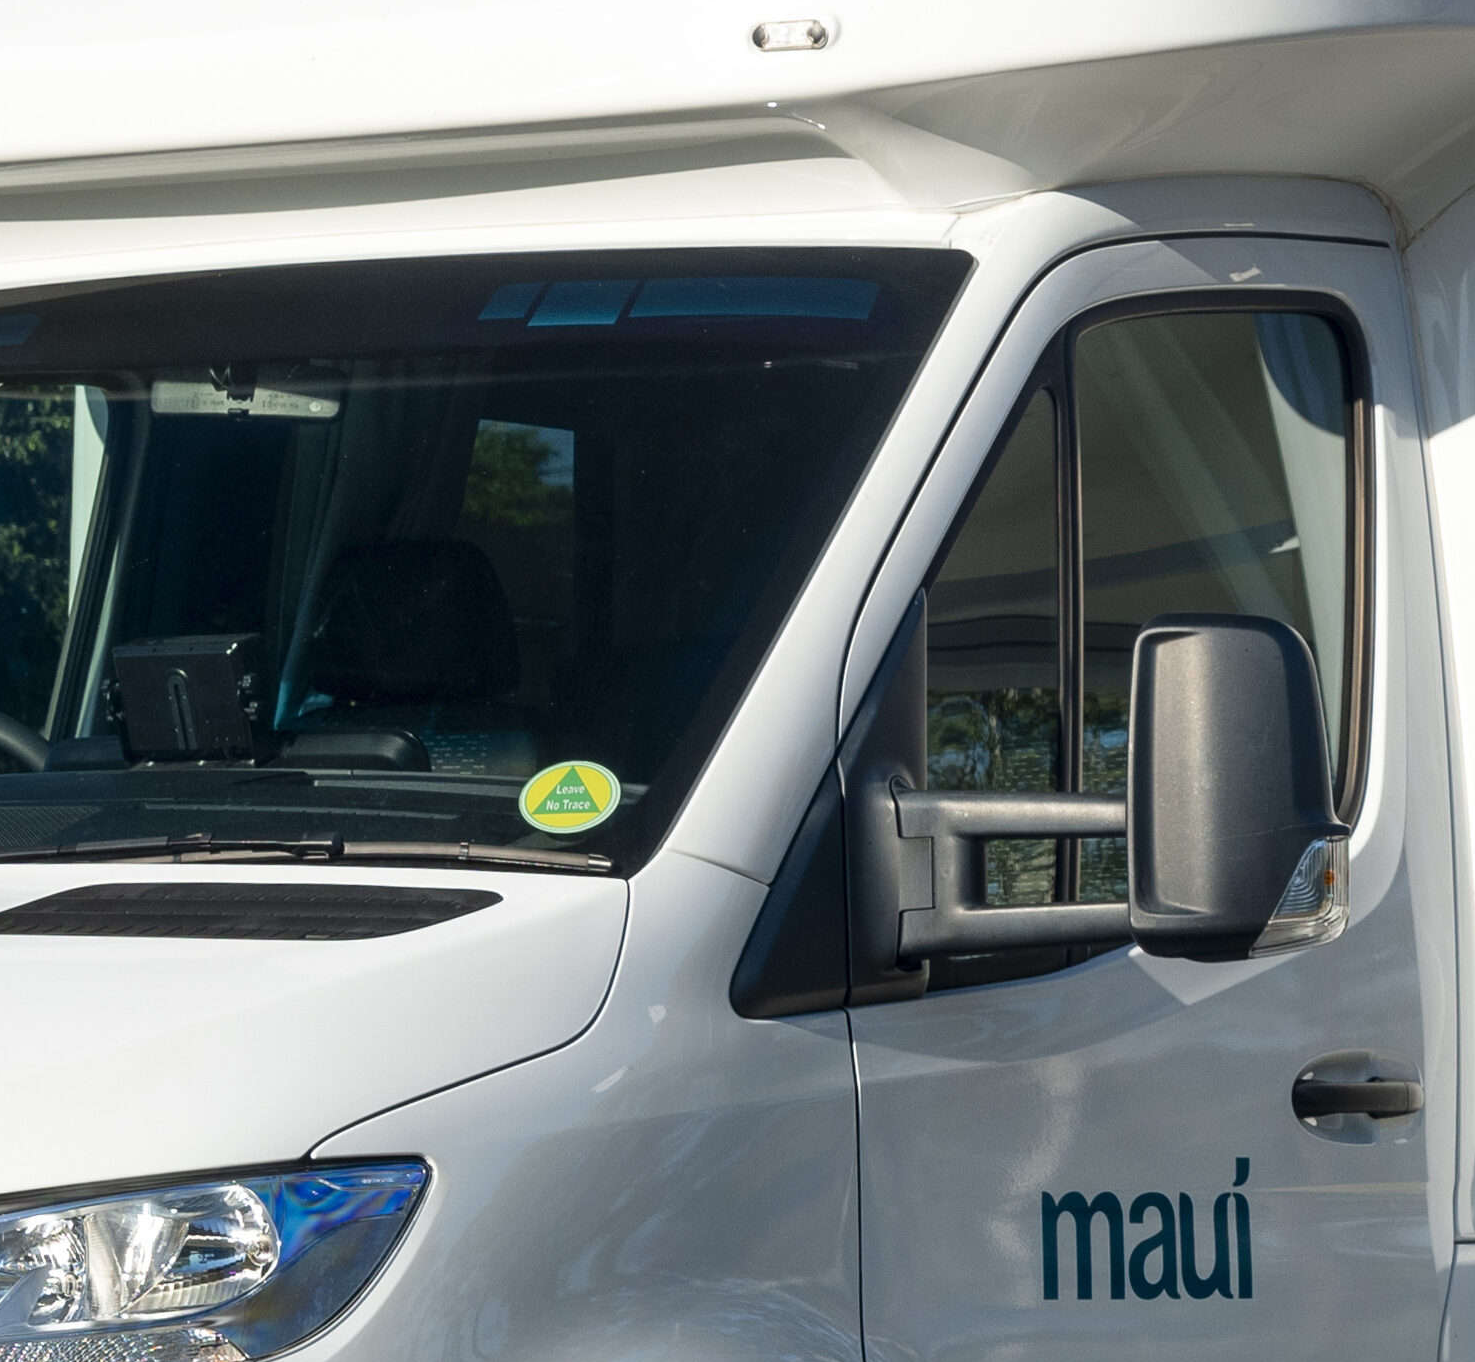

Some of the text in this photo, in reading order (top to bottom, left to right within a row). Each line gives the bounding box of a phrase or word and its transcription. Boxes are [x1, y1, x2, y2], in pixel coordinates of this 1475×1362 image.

[556, 784, 585, 796] Leave
[546, 798, 591, 811] No Trace
